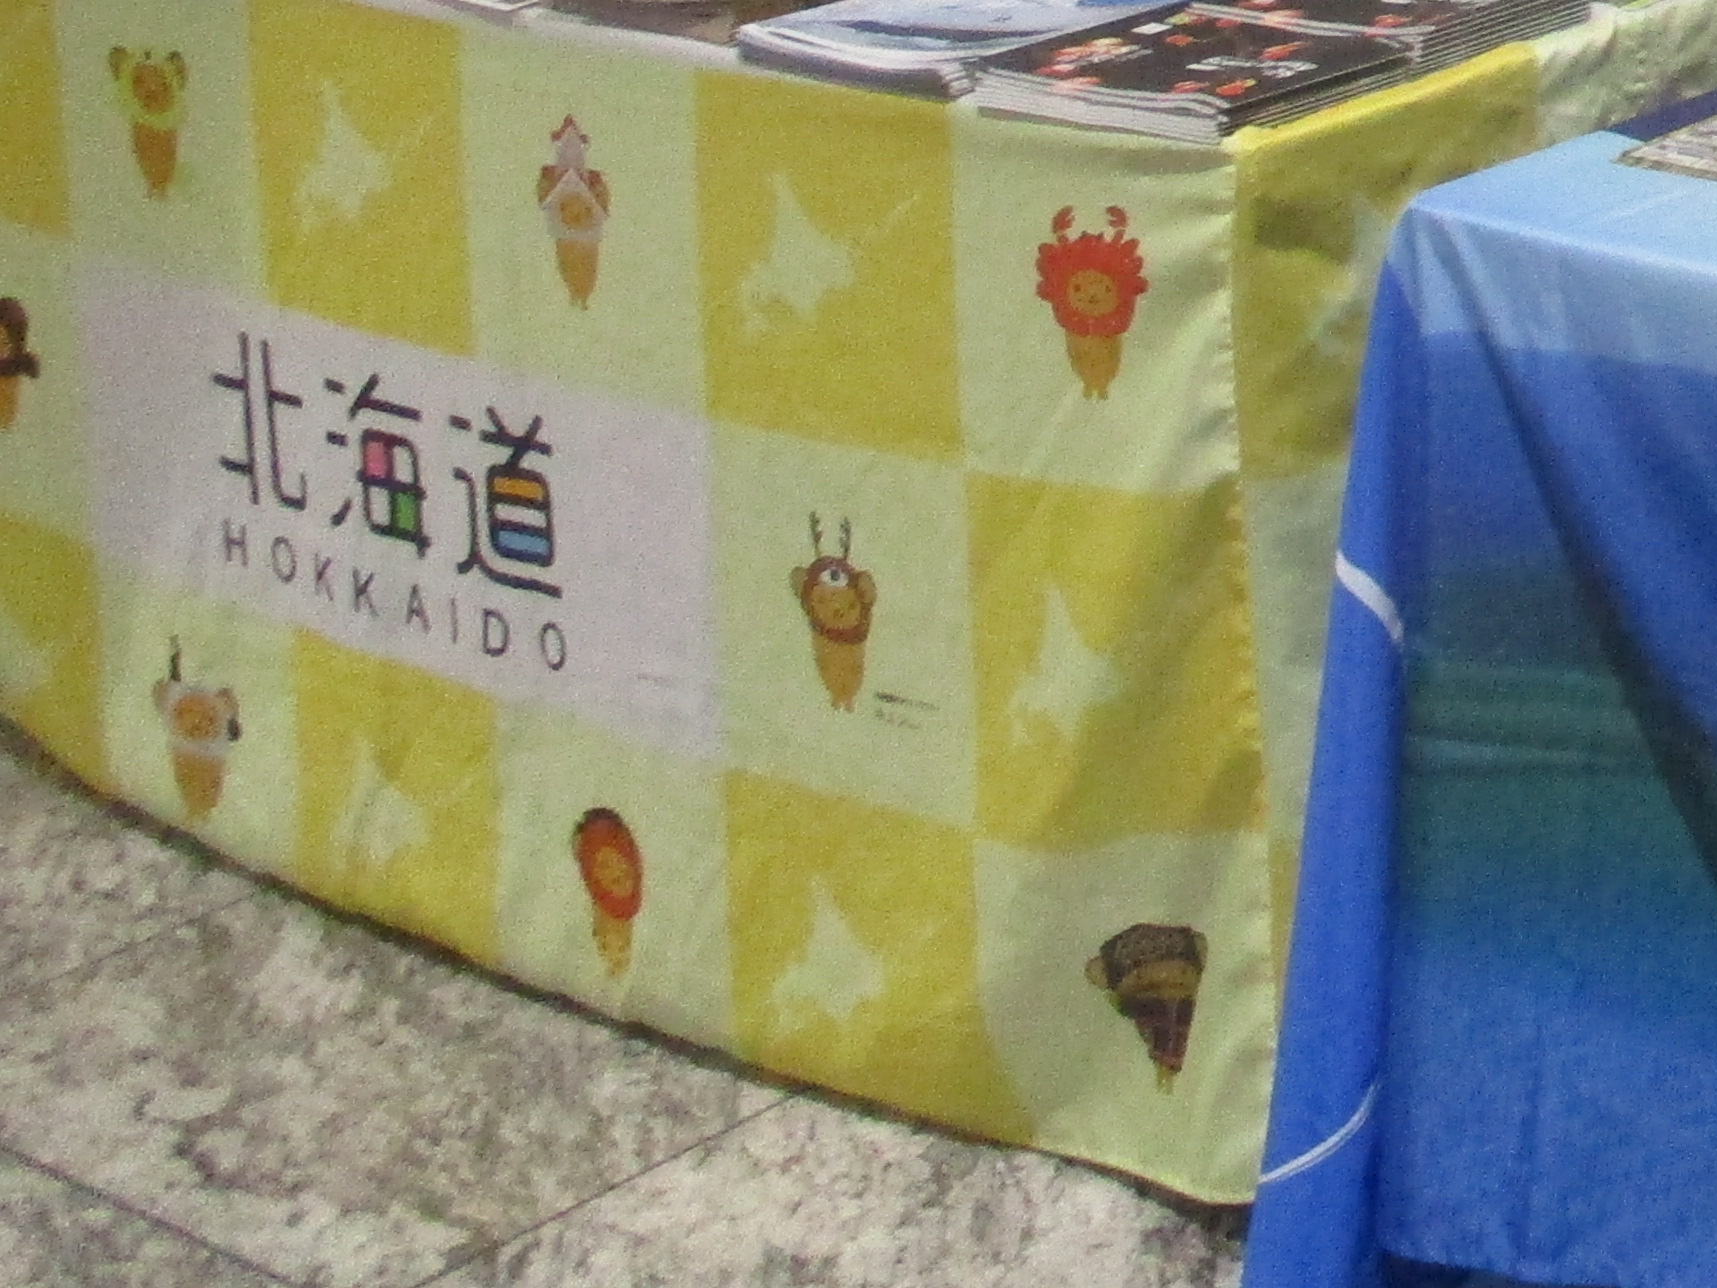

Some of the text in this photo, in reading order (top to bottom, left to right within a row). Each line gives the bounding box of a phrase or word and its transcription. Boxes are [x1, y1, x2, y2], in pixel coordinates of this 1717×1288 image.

[211, 330, 563, 600] 北海道
[221, 518, 568, 673] HOKKAIDO
